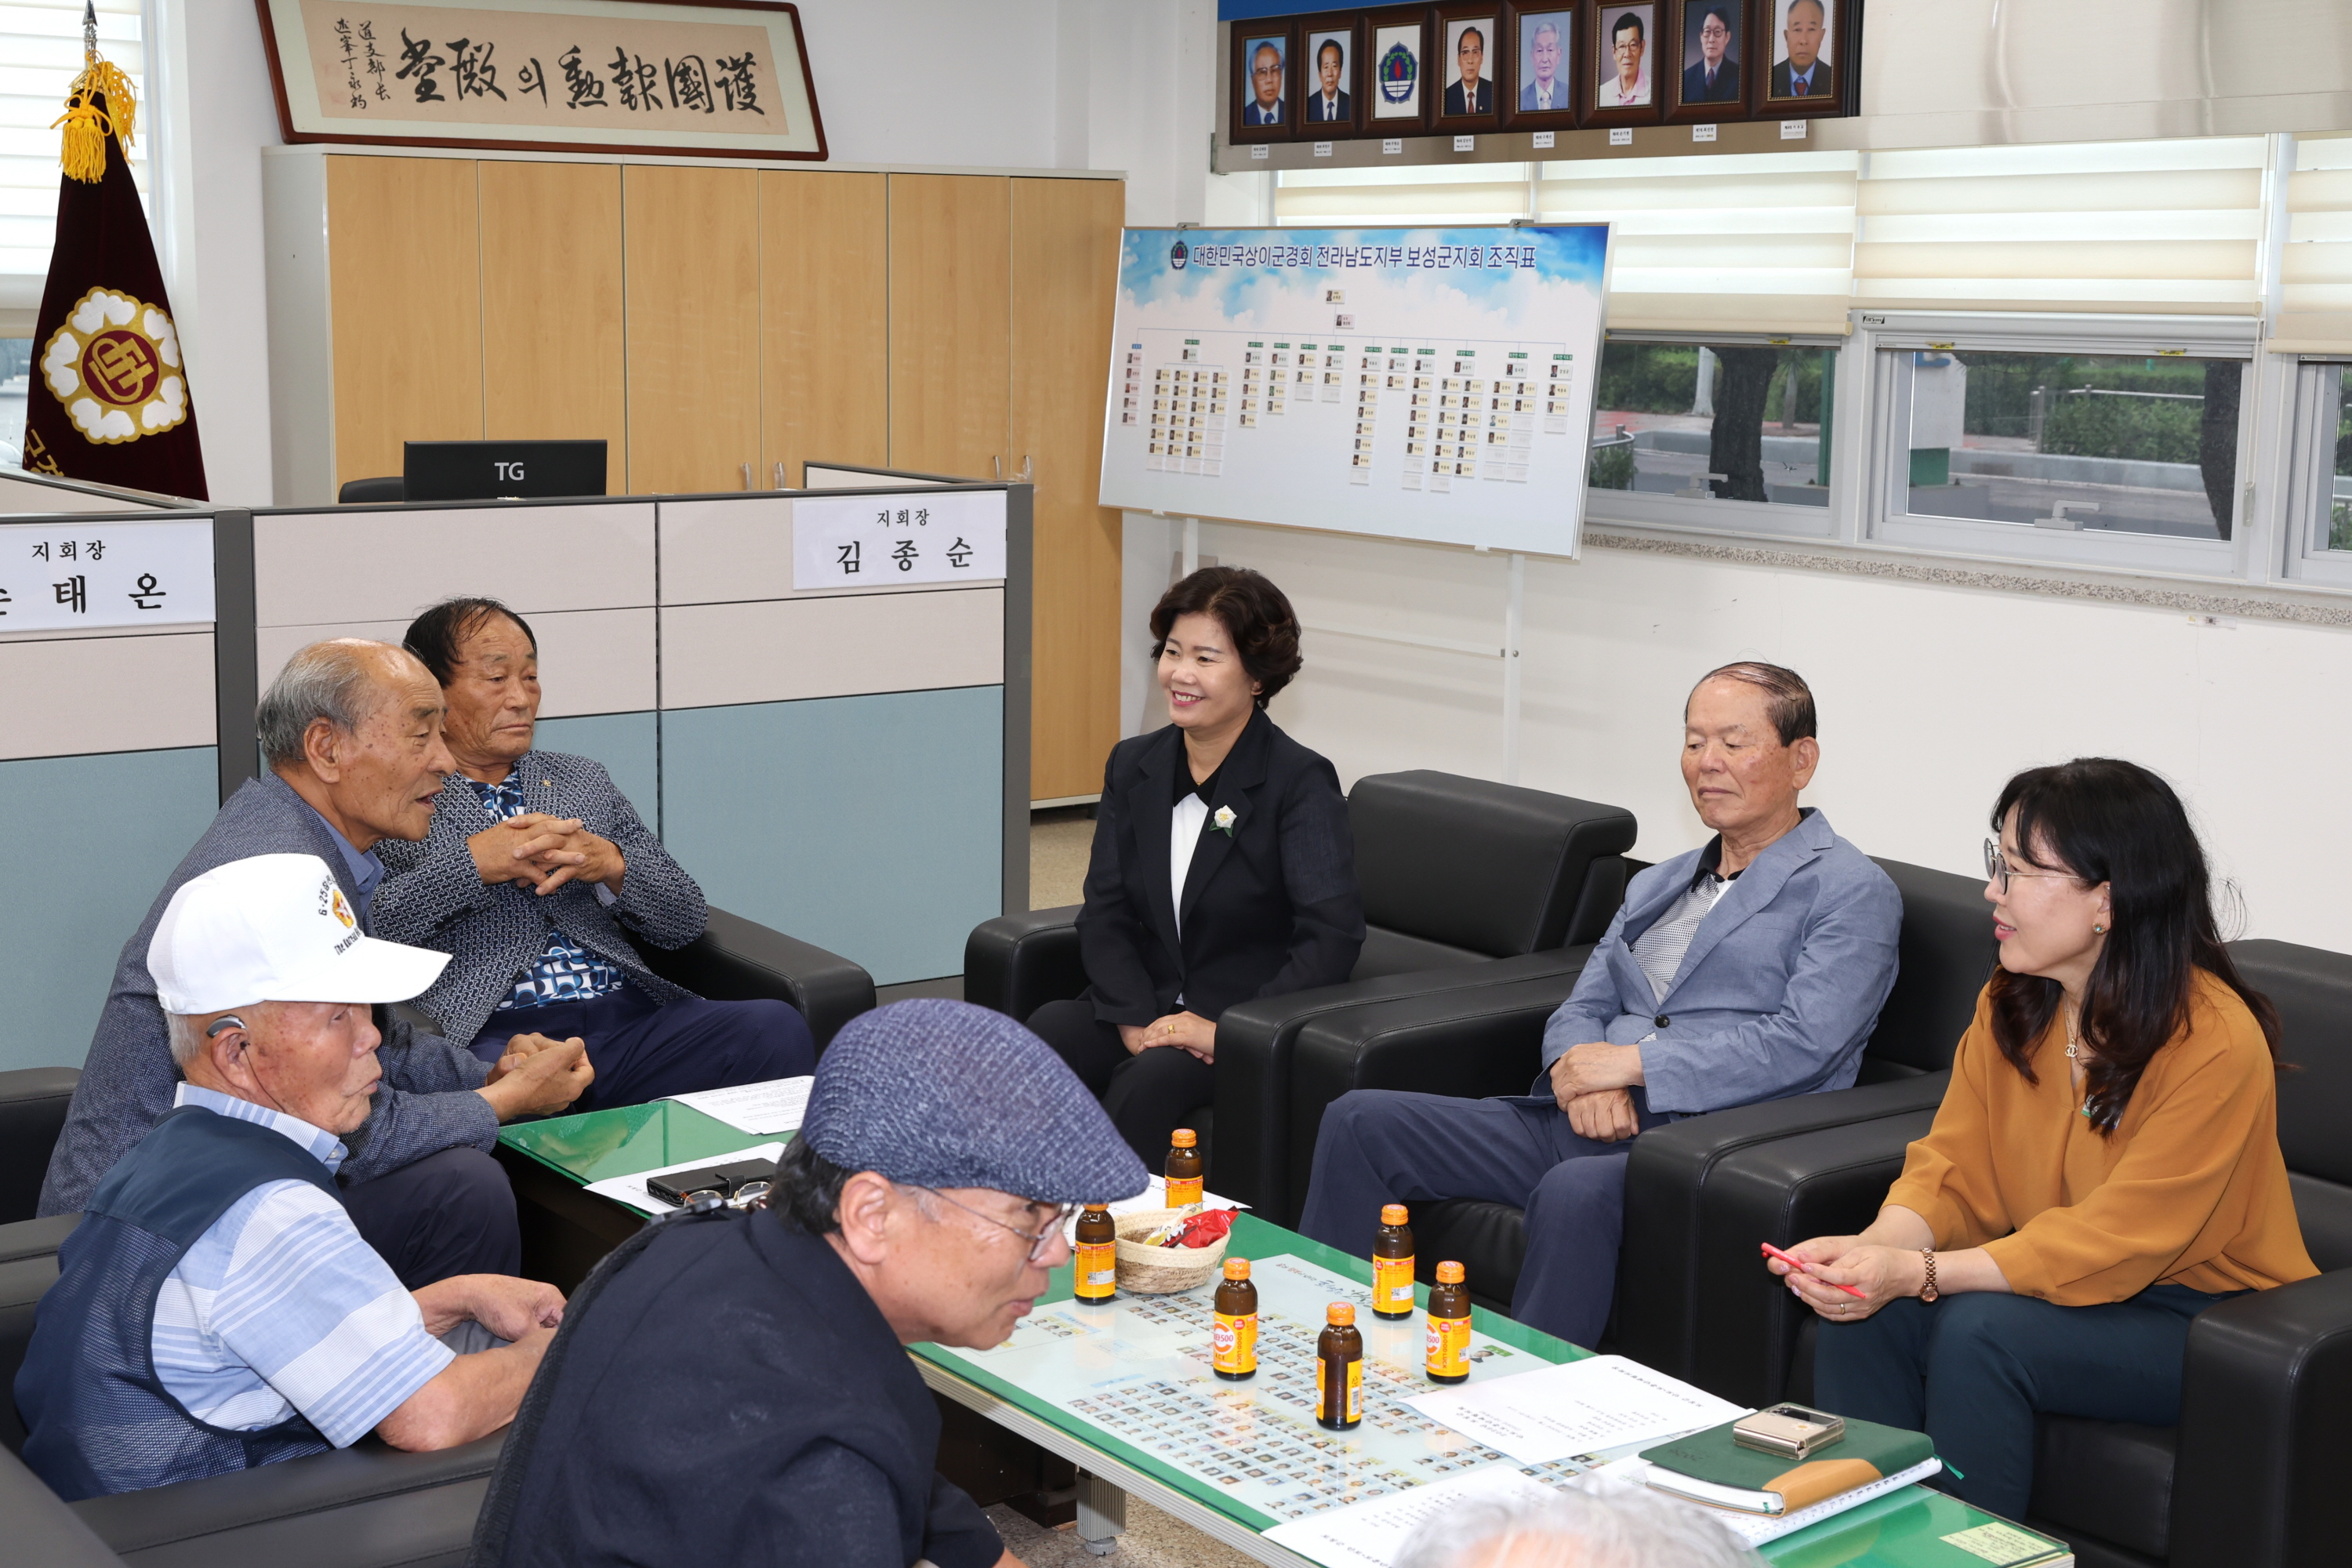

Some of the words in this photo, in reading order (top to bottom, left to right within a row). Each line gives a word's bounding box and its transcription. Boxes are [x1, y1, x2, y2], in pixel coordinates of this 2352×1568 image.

[1193, 245, 1312, 267] 대한민국상이군경회
[1316, 245, 1402, 268] 전라남도지부
[1406, 246, 1484, 269] 보성군지회
[1487, 246, 1536, 269] 조직표
[494, 462, 524, 481] TG
[877, 508, 930, 528] 지회장
[31, 539, 106, 562] 지회장
[837, 537, 974, 574] 김종순
[0, 573, 166, 614] 태온
